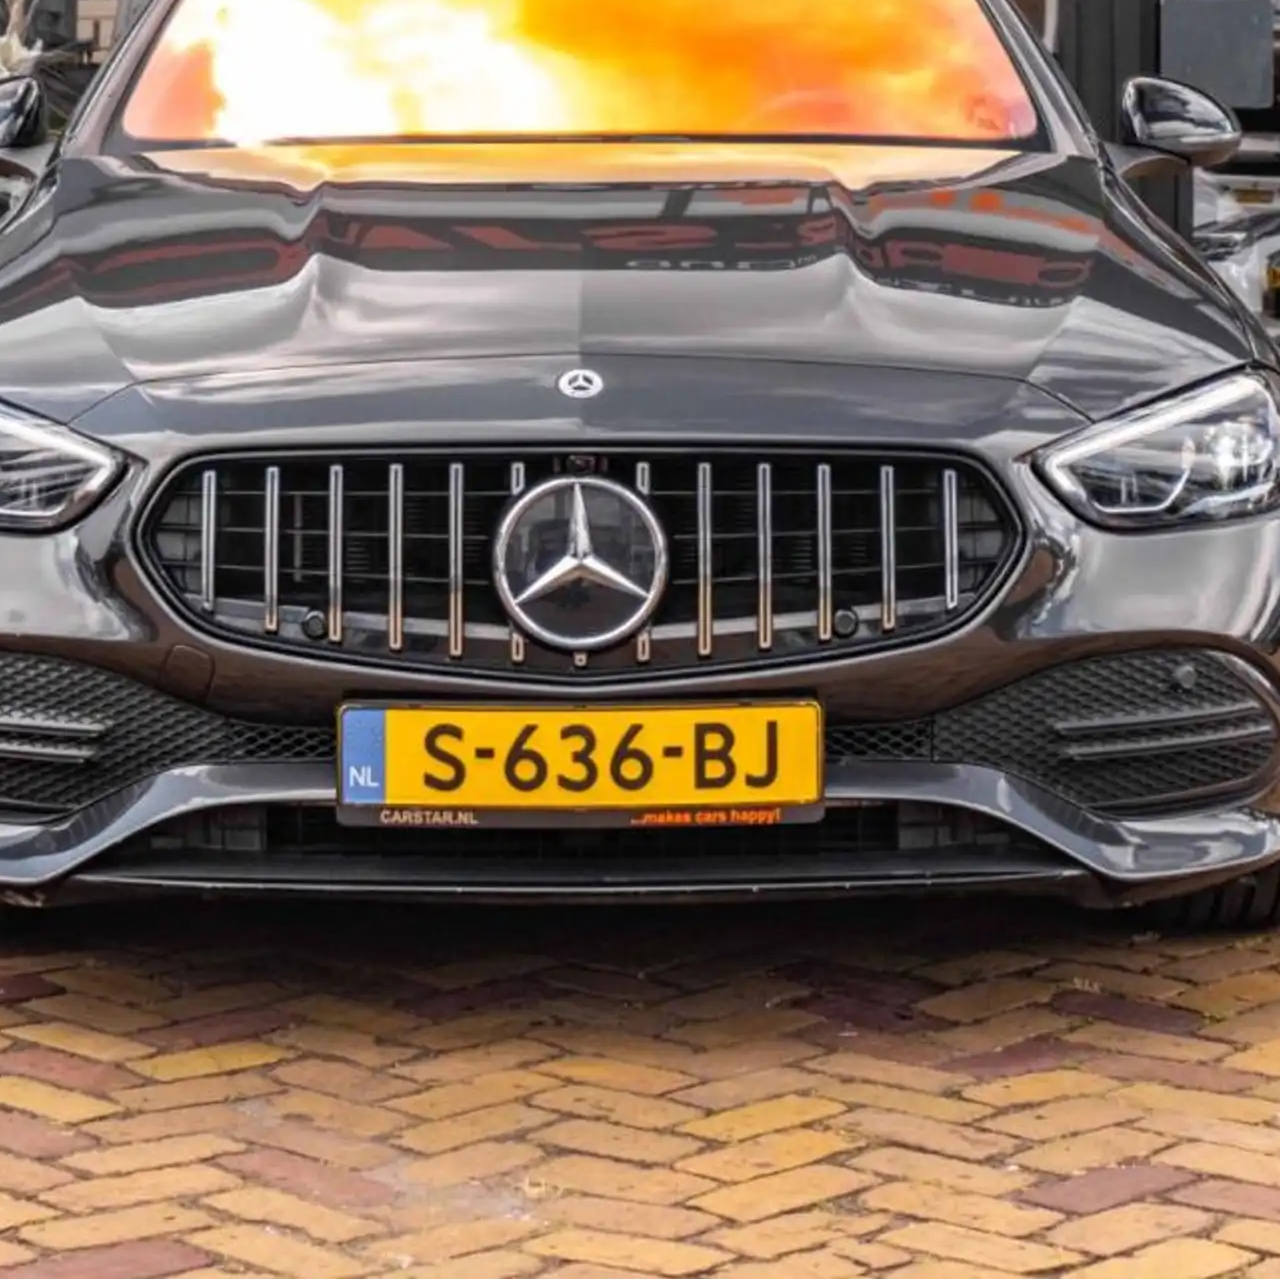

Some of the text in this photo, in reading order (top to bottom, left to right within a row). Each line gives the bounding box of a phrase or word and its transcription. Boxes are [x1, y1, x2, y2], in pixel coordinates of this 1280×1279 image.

[422, 719, 781, 792] S-636-BJ
[348, 765, 380, 788] NL
[380, 808, 480, 825] CARSTAR.NL
[695, 808, 727, 825] cars
[730, 806, 784, 826] happy!
